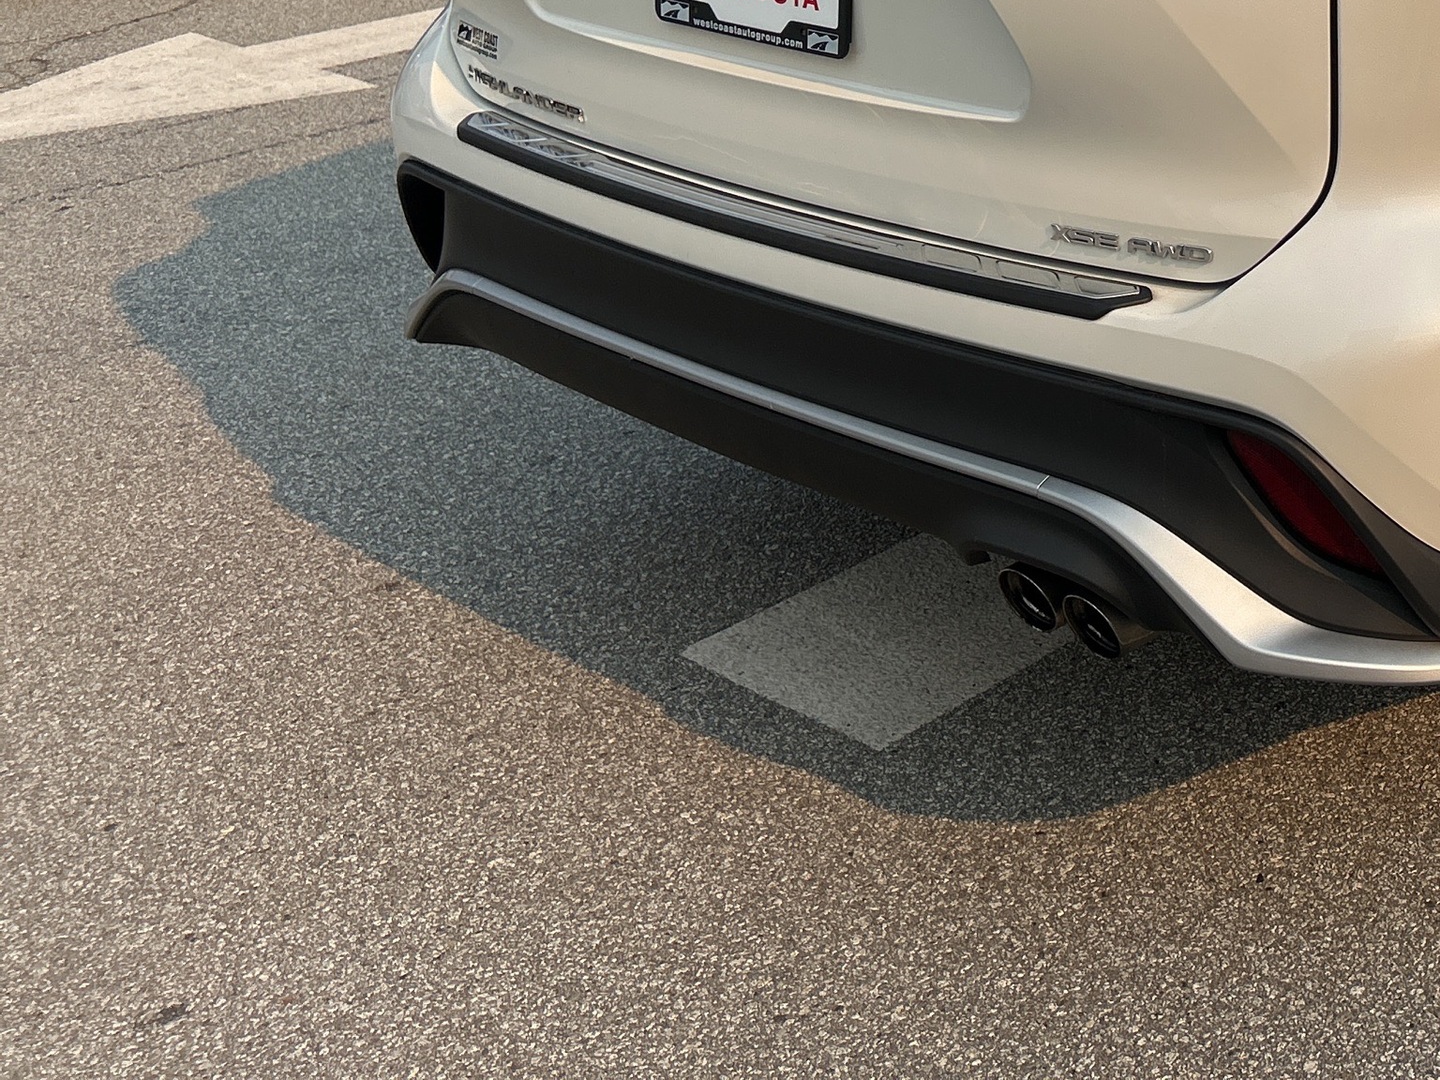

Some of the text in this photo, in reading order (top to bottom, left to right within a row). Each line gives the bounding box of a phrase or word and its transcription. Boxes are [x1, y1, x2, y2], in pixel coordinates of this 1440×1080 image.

[693, 17, 804, 49] westcoastautogroup.com
[1050, 222, 1214, 264] XSE AWD
